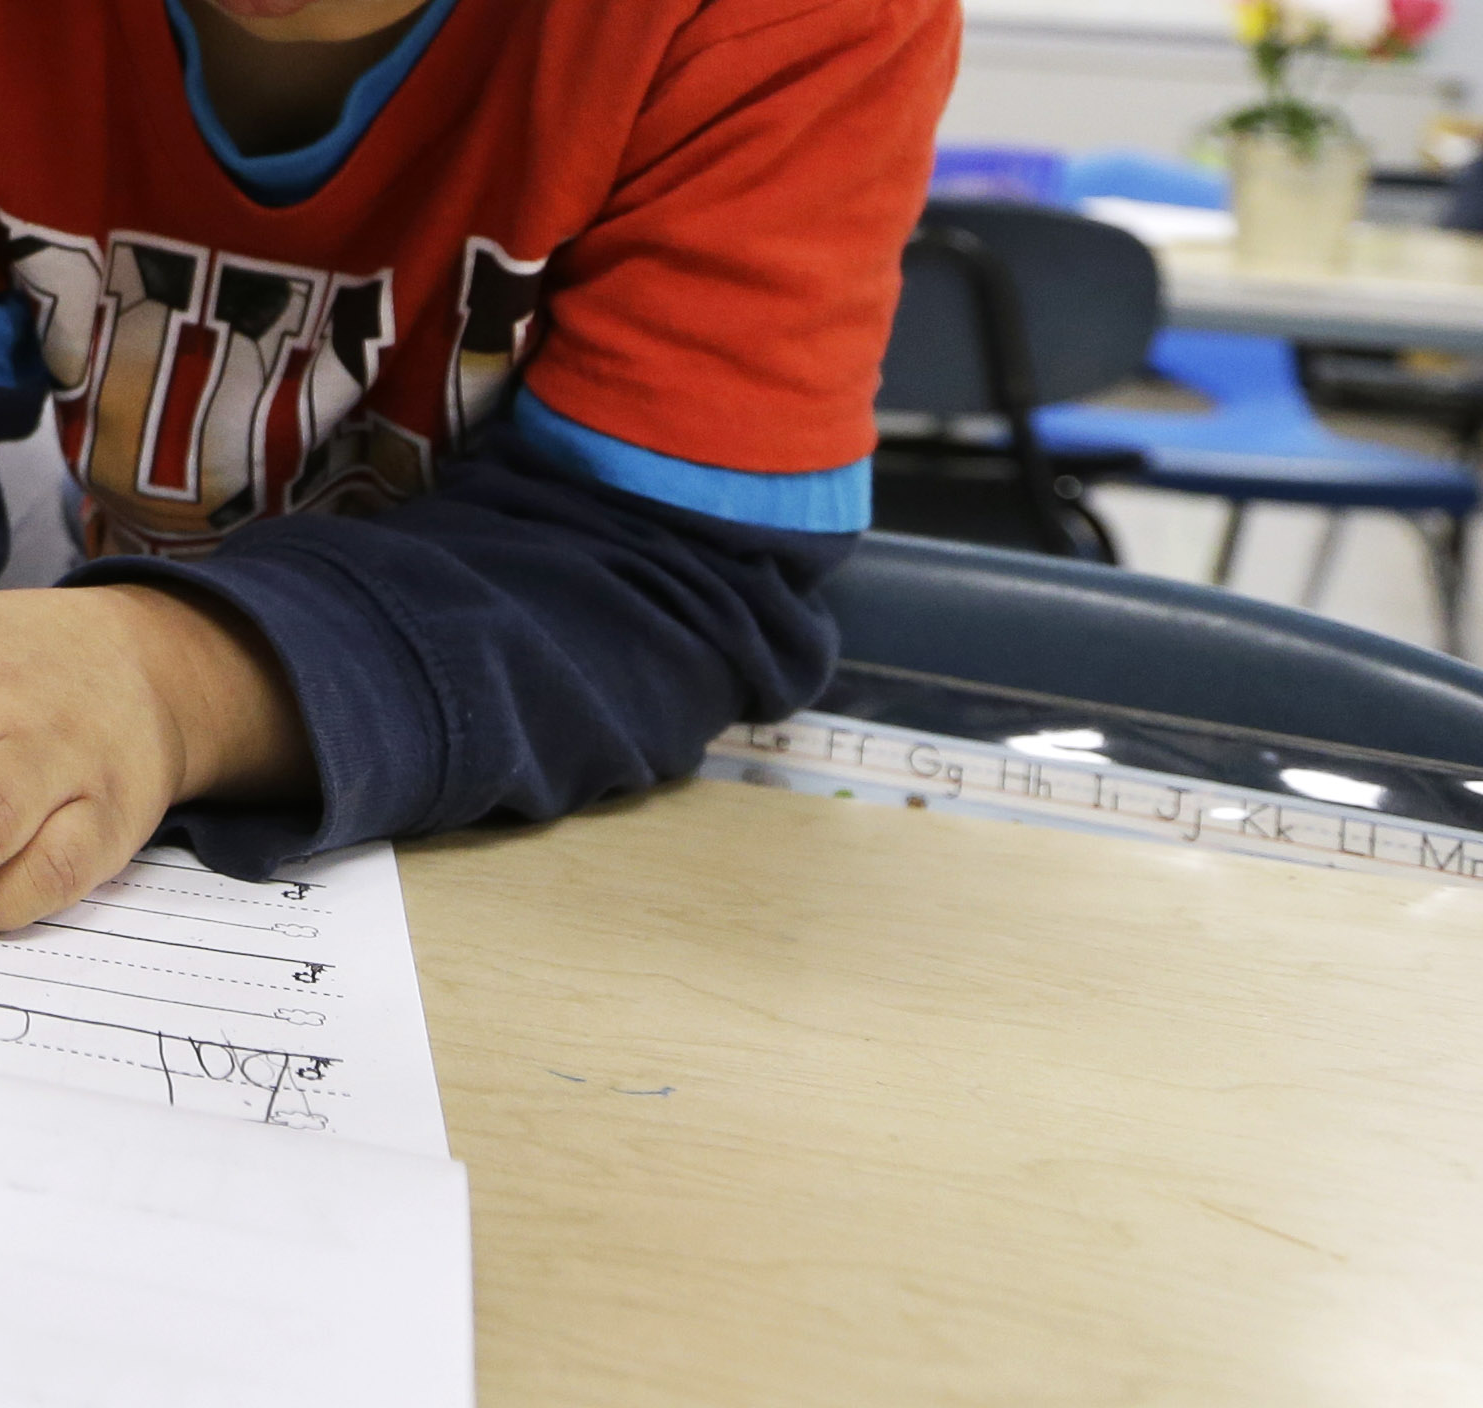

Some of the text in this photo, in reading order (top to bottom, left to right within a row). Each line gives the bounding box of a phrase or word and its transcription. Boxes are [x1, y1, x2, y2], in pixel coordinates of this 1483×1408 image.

[827, 727, 875, 766] Ff
[908, 743, 964, 799] Gg
[1001, 757, 1053, 799] Hh
[1156, 786, 1202, 842] Jj
[1241, 798, 1294, 843] Kk
